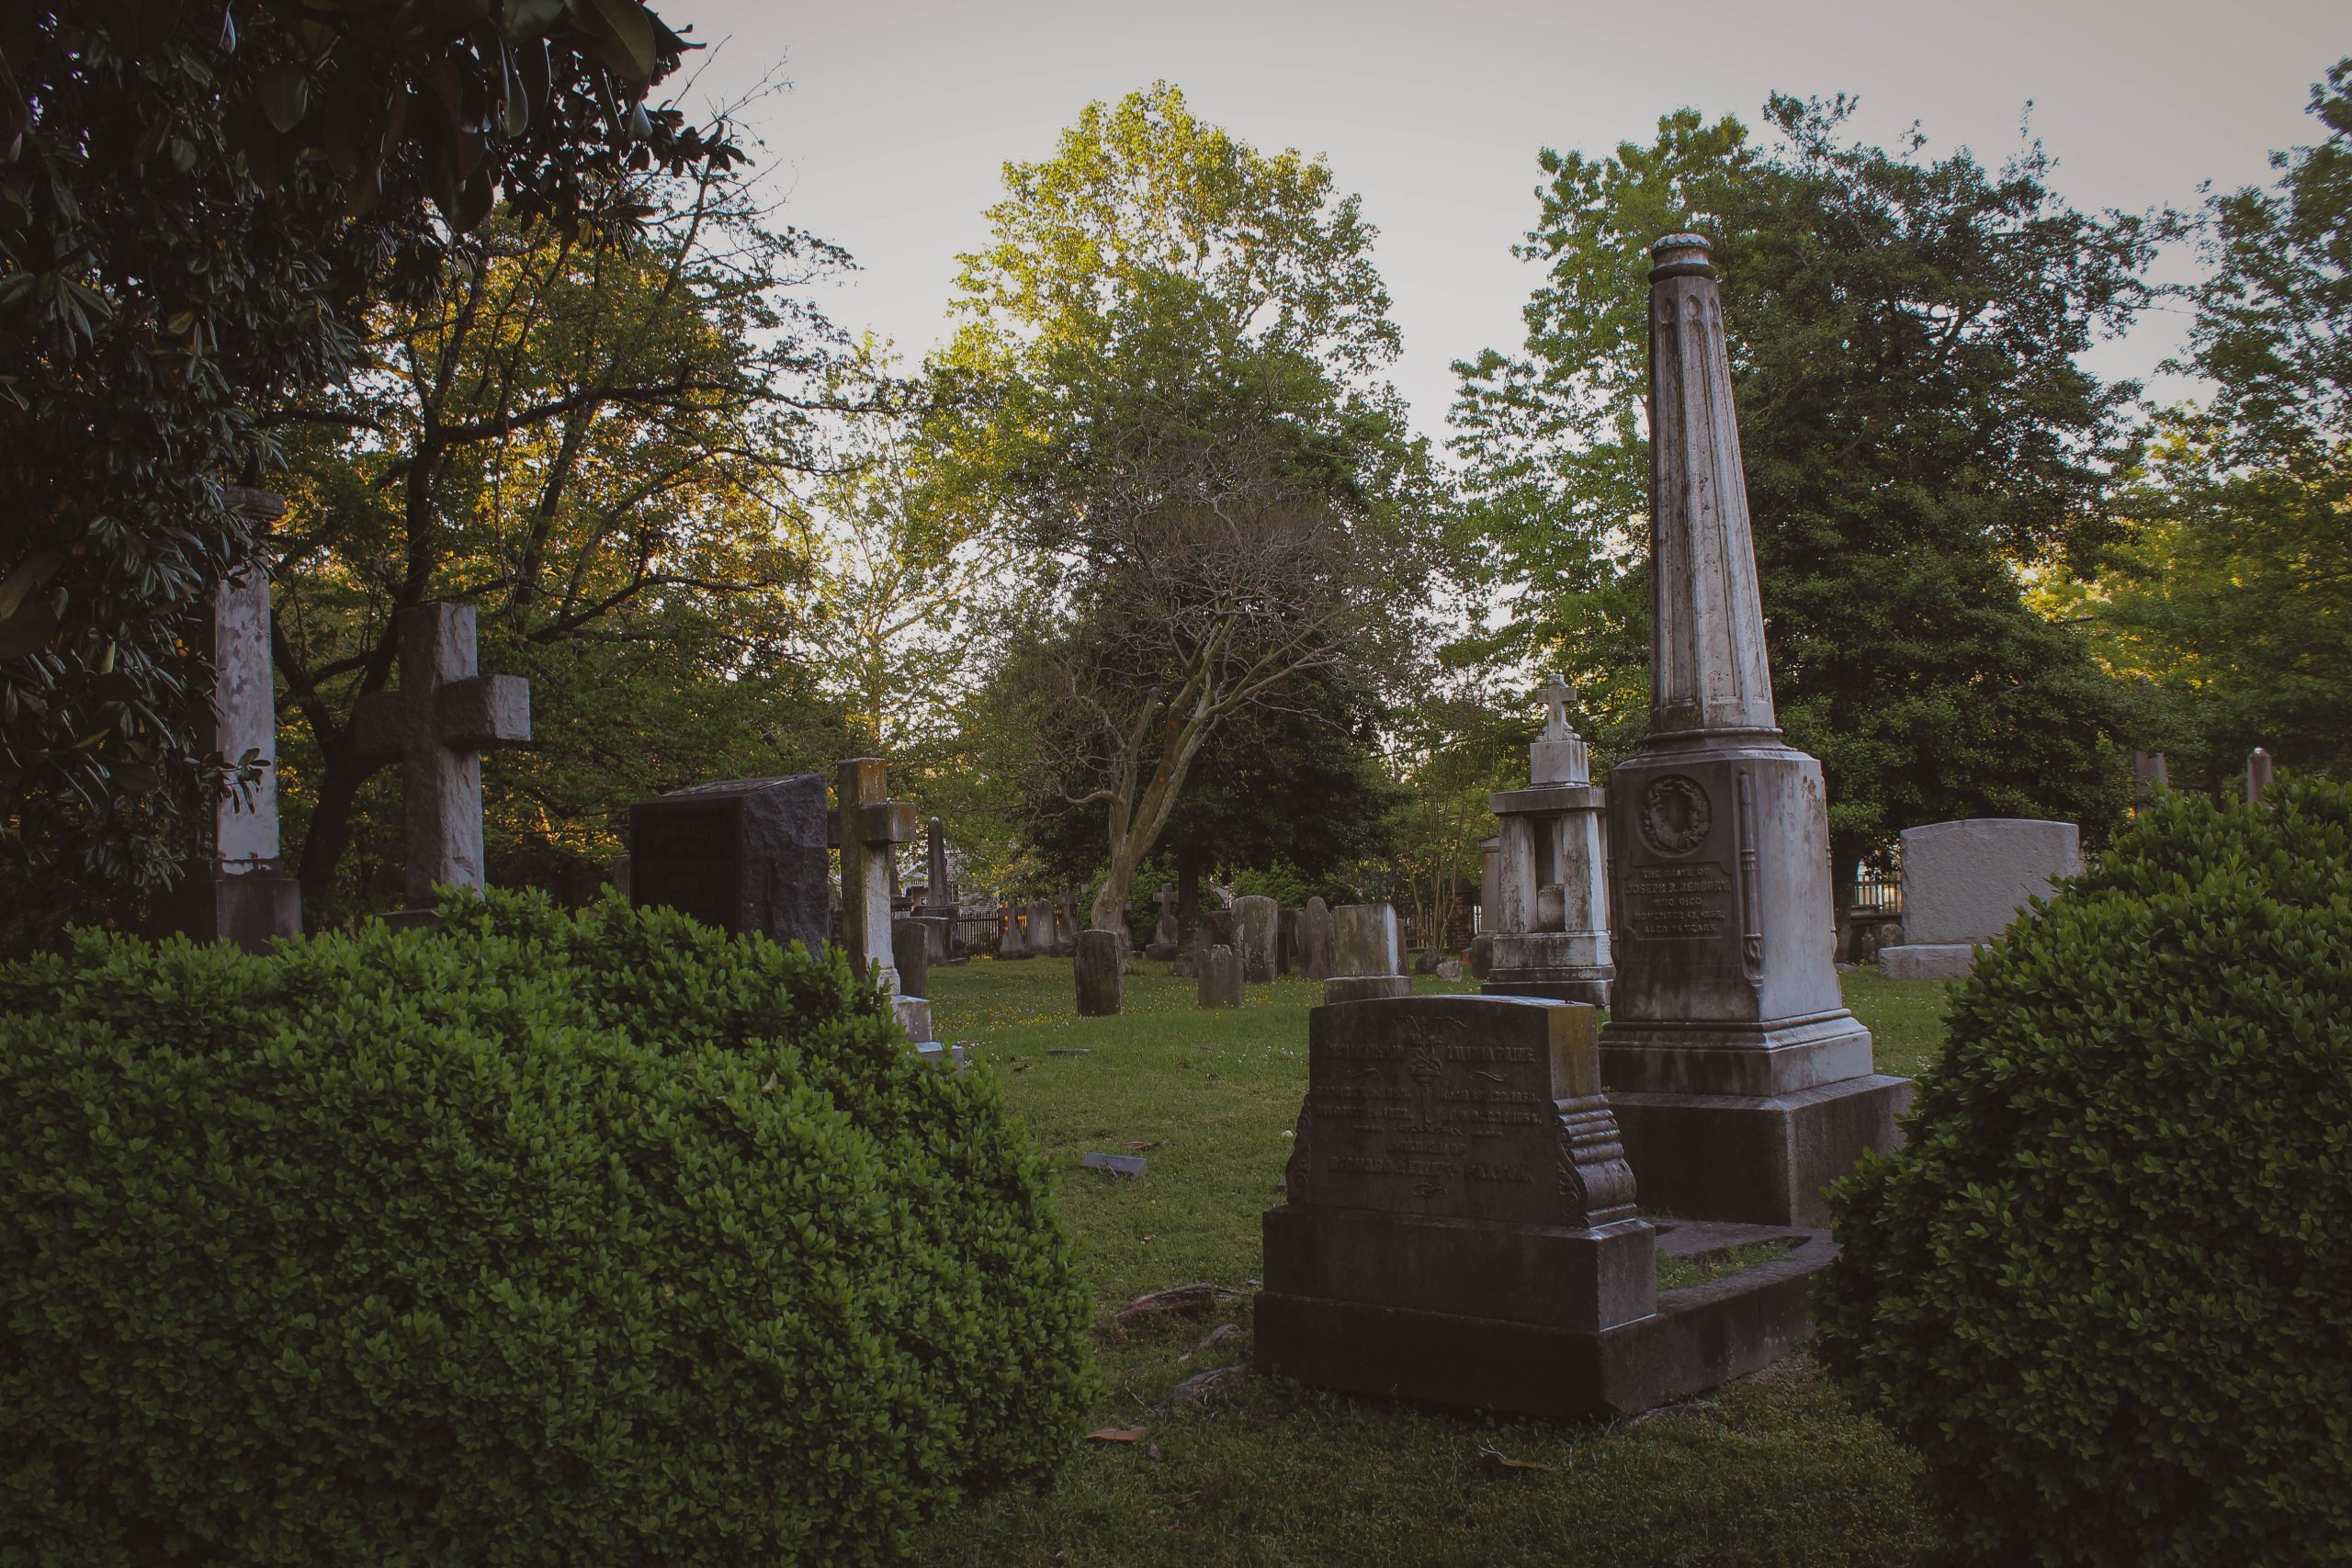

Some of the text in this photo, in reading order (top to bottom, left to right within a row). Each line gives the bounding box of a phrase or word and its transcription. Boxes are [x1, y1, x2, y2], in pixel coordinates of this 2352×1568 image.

[1642, 869, 1661, 879] THE
[1625, 883, 1666, 895] JOSEPH
[1679, 897, 1703, 906] DIED
